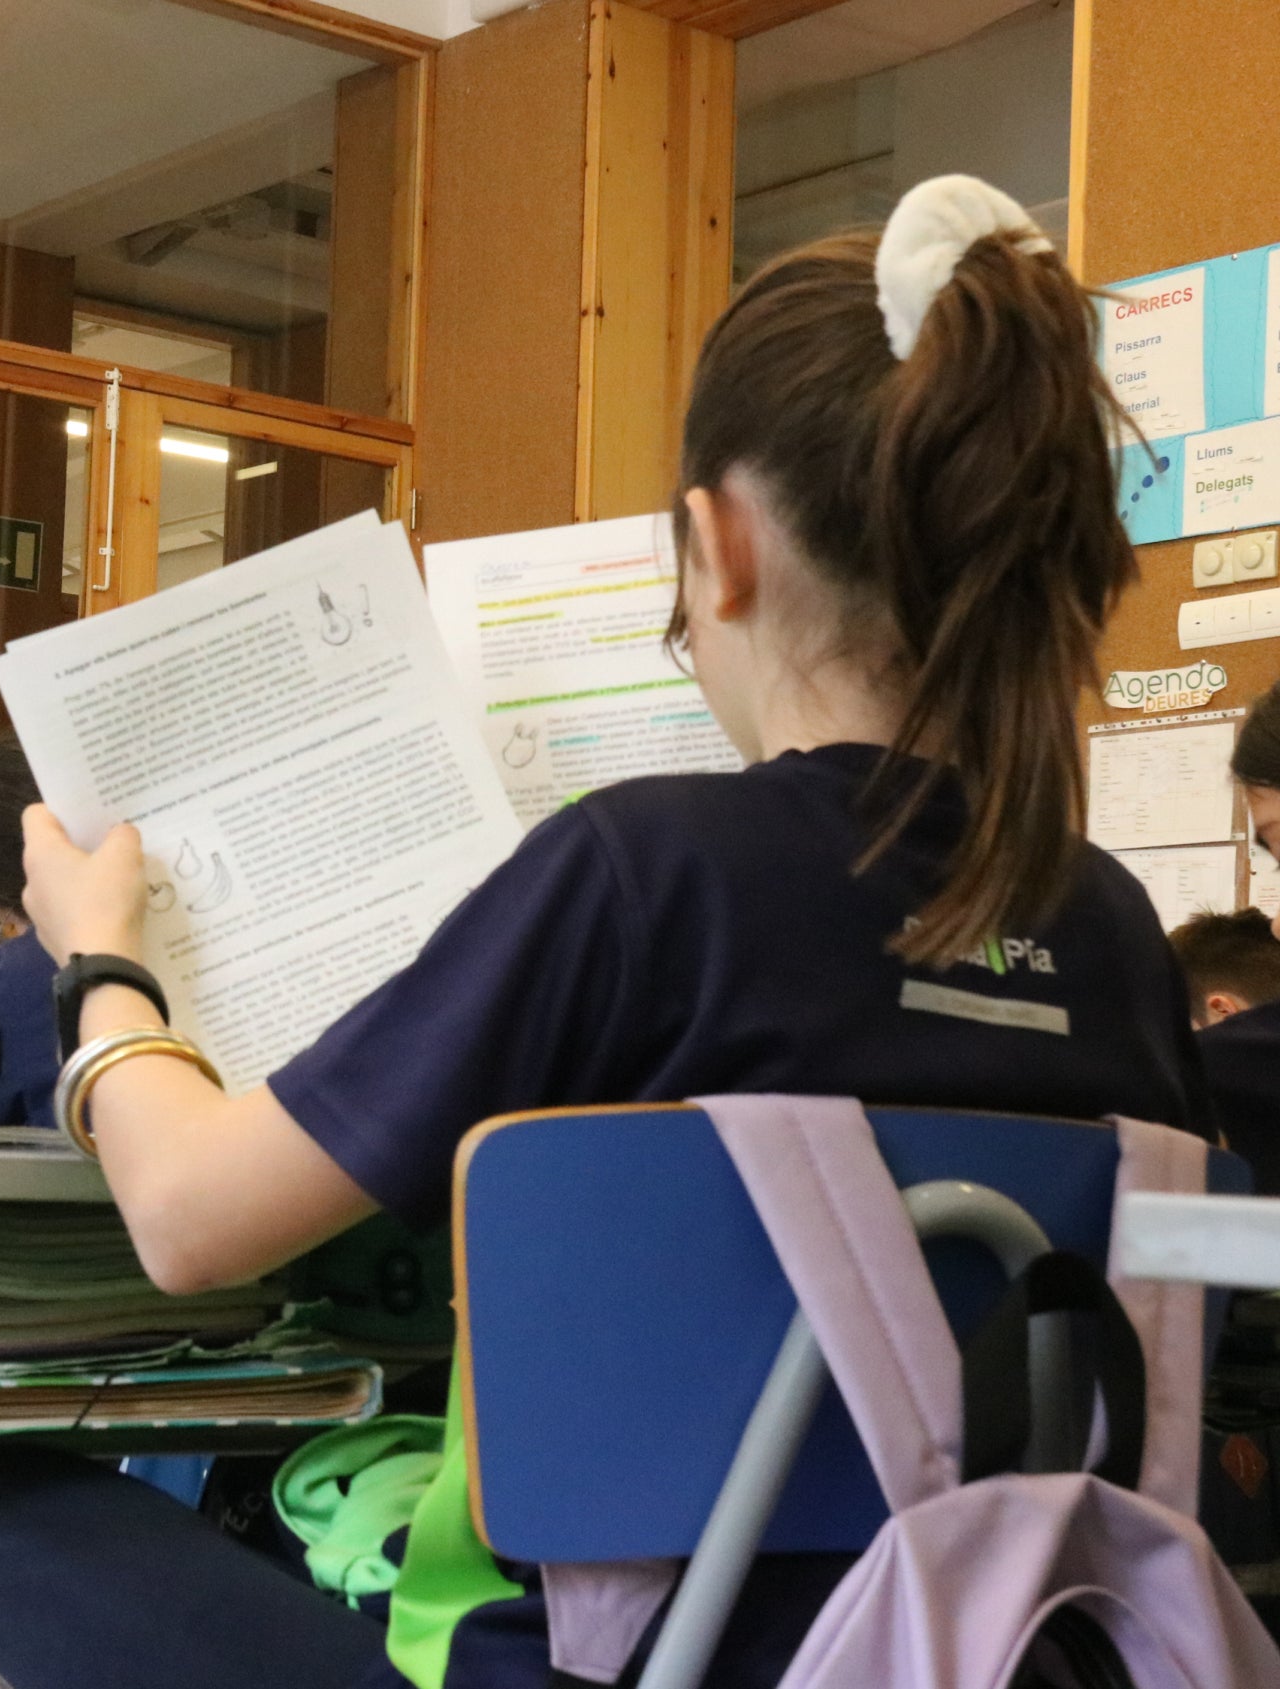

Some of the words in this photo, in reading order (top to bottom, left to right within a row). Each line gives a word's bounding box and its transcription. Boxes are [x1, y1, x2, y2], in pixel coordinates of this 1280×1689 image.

[1115, 335, 1162, 353] Pissarra
[1115, 370, 1147, 385] Claus
[1121, 396, 1160, 413] aterial
[1196, 446, 1233, 461] Llums
[1195, 474, 1254, 494] Delegats
[1103, 664, 1226, 704] Agenda
[1145, 689, 1211, 712] DEURES
